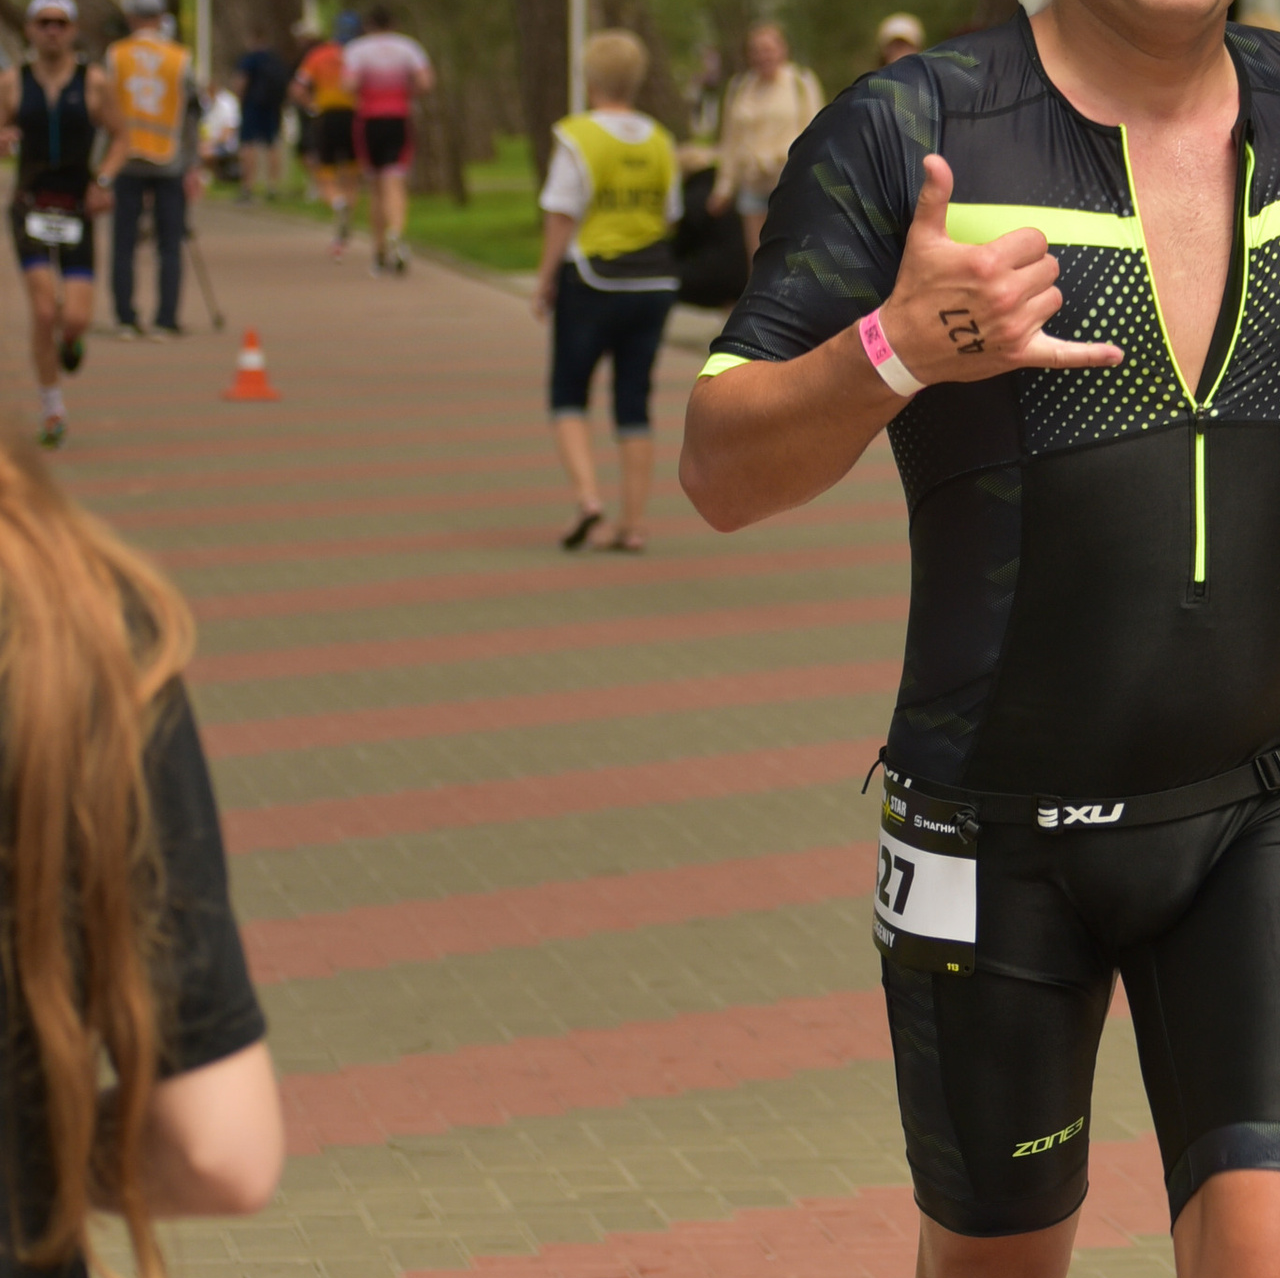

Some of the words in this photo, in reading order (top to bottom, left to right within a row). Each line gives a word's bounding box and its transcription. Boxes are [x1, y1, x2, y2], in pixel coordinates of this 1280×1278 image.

[939, 309, 985, 355] 427
[923, 819, 956, 834] МАГНИ
[876, 844, 915, 916] 27
[947, 962, 960, 972] 113
[1011, 1116, 1084, 1158] ZONE3
